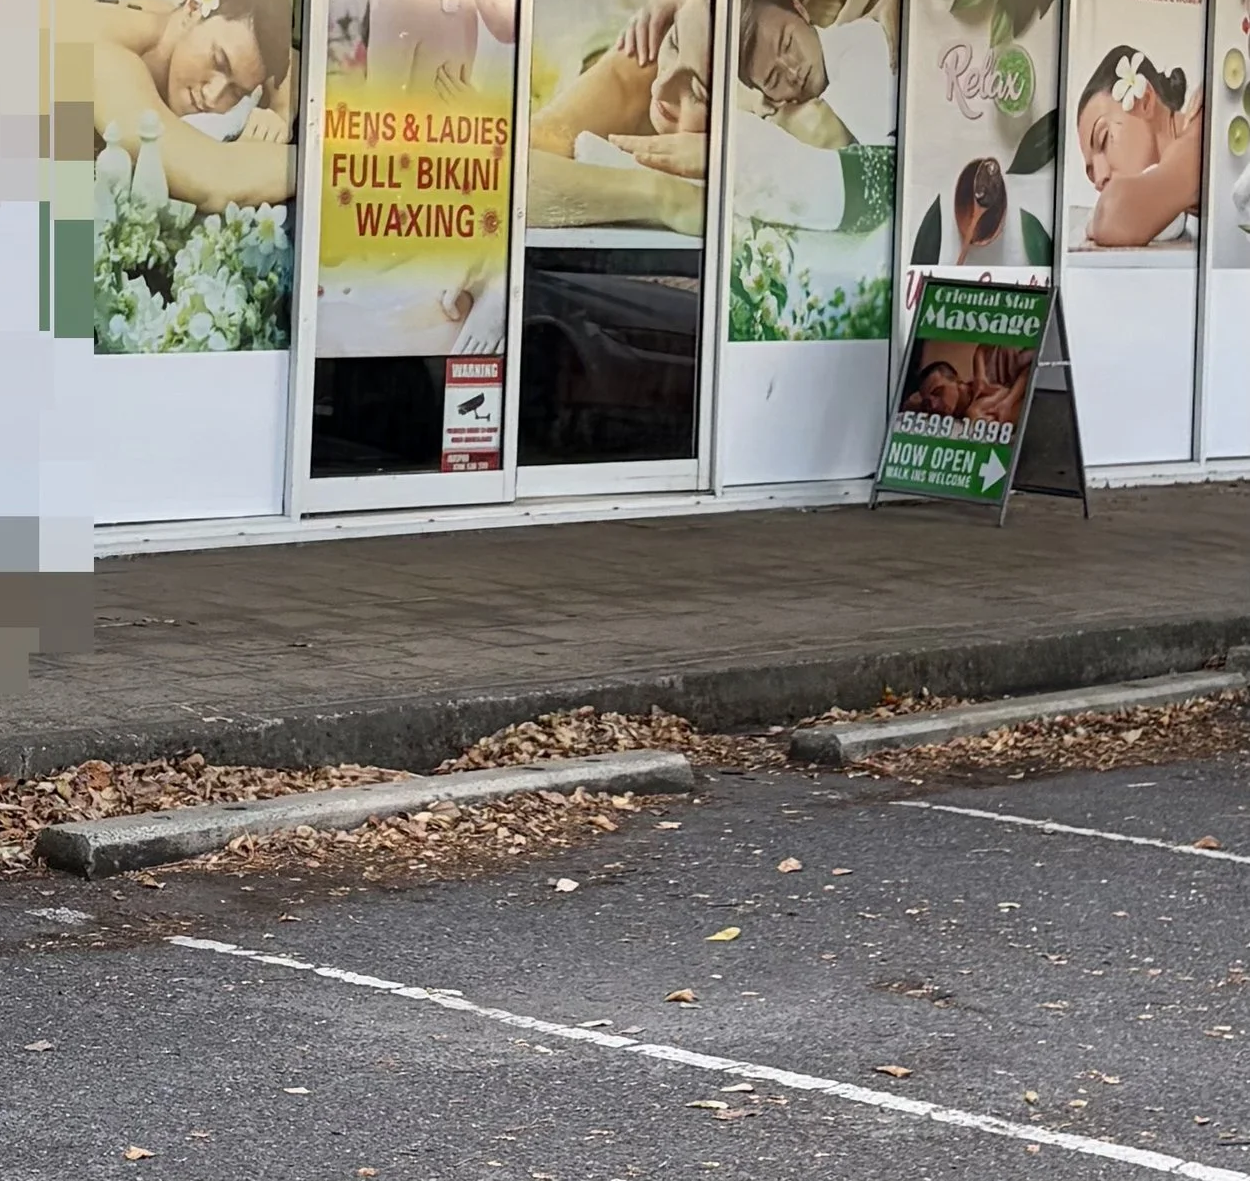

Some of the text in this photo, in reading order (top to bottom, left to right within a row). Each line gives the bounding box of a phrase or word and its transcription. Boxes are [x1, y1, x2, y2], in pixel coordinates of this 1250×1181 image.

[938, 42, 1026, 121] Relax
[324, 109, 508, 146] MENS & LADIES
[332, 153, 500, 191] FULL BIKINI
[356, 202, 475, 238] WAXING
[934, 287, 1001, 308] Oriental
[1005, 292, 1040, 311] Star
[919, 304, 1041, 338] Massage
[901, 410, 1014, 445] 5599 1998
[888, 441, 977, 474] NOW OPEN
[884, 465, 973, 489] WALK INS WELCOME
